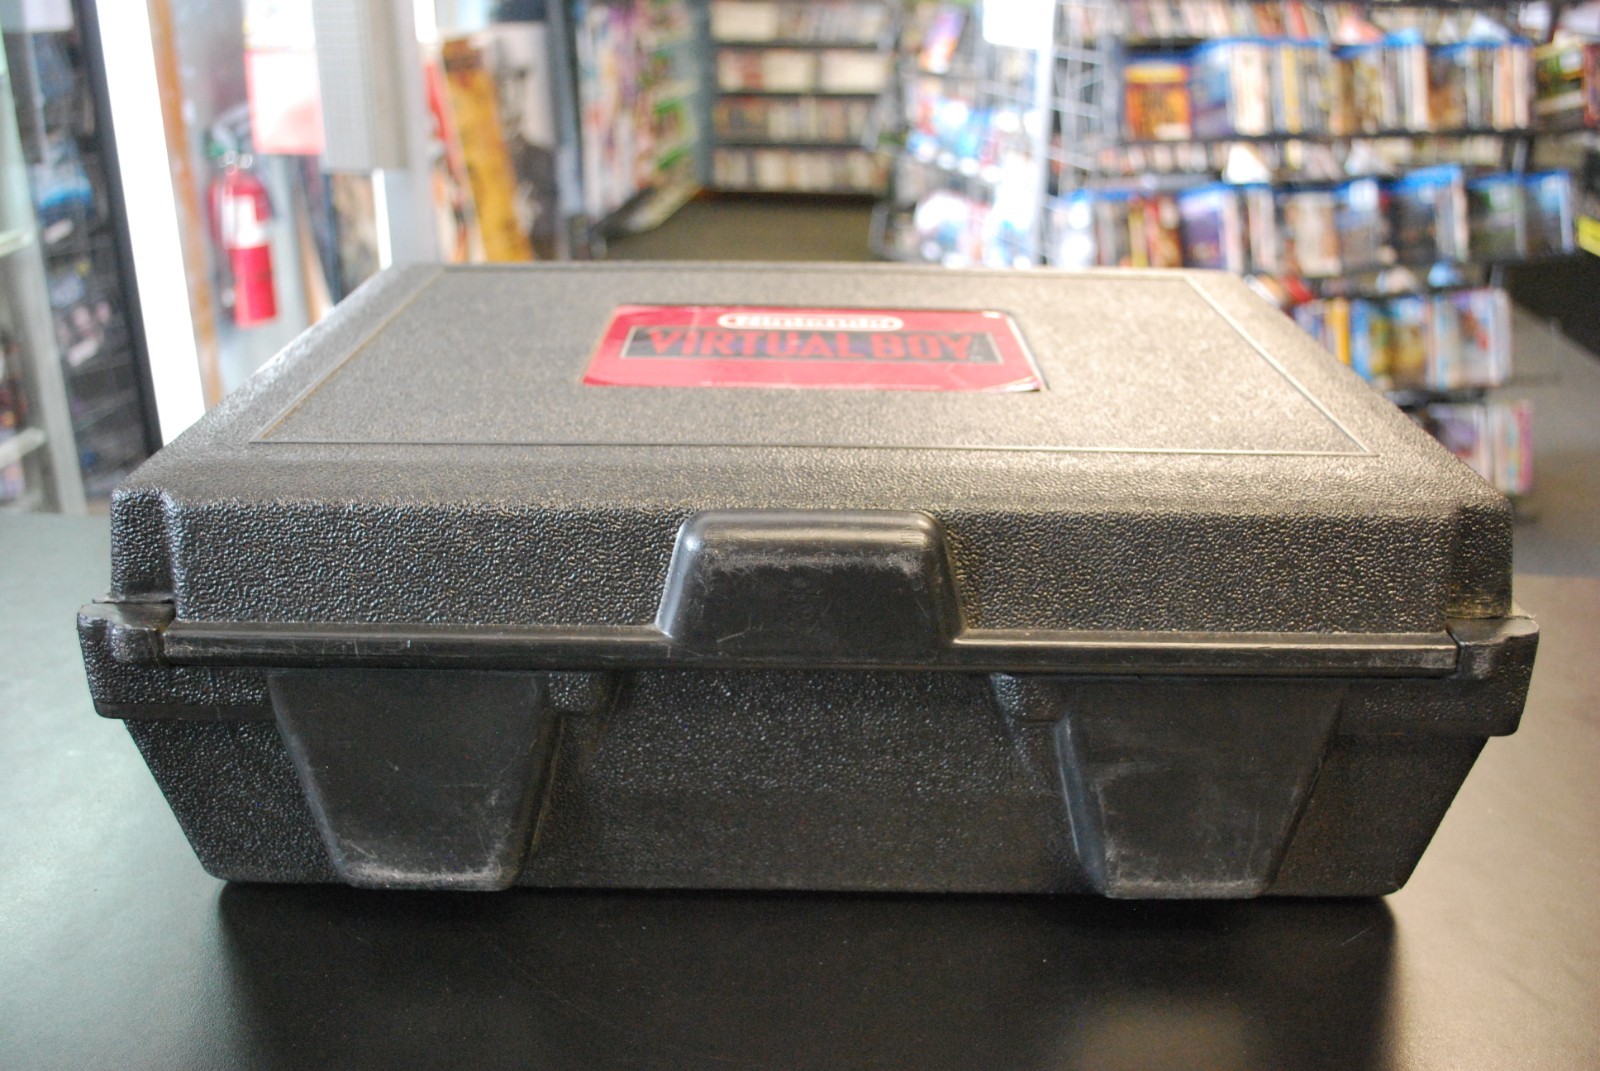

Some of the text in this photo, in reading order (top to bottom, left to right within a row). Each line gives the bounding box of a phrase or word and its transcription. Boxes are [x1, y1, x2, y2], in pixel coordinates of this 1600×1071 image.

[731, 314, 890, 329] Nintendo
[648, 330, 973, 360] VIRTUAL BOY
